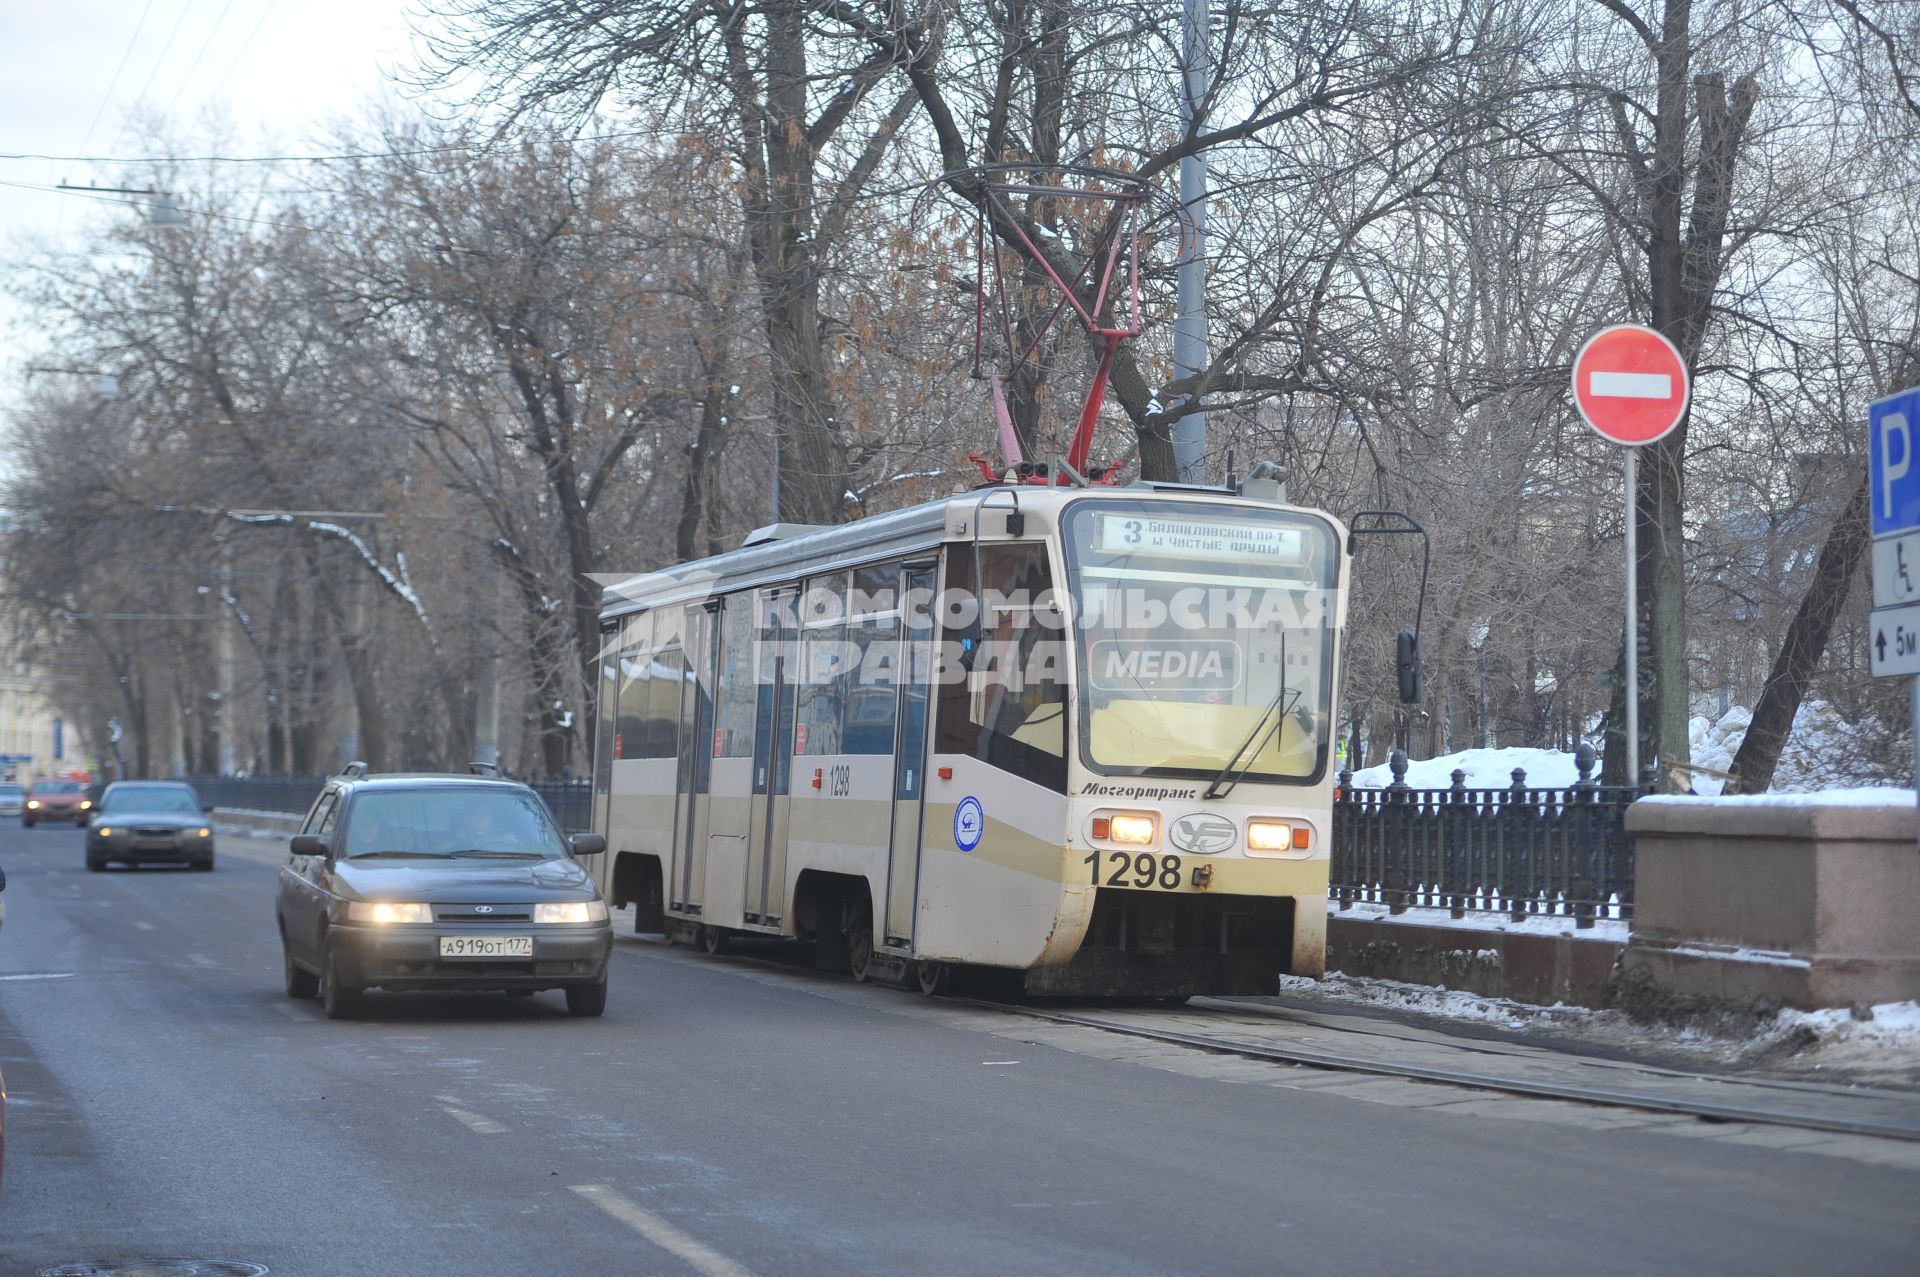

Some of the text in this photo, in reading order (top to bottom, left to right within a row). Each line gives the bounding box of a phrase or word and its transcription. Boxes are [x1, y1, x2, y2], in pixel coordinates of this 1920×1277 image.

[1880, 412, 1911, 518] P
[1124, 520, 1143, 544] 3
[1169, 537, 1223, 551] ЧИСТЫЕ
[1230, 542, 1280, 555] ПРУДЫ
[830, 765, 850, 797] 1298
[1081, 782, 1197, 801] Мосгортранс
[1084, 850, 1181, 889] 1298
